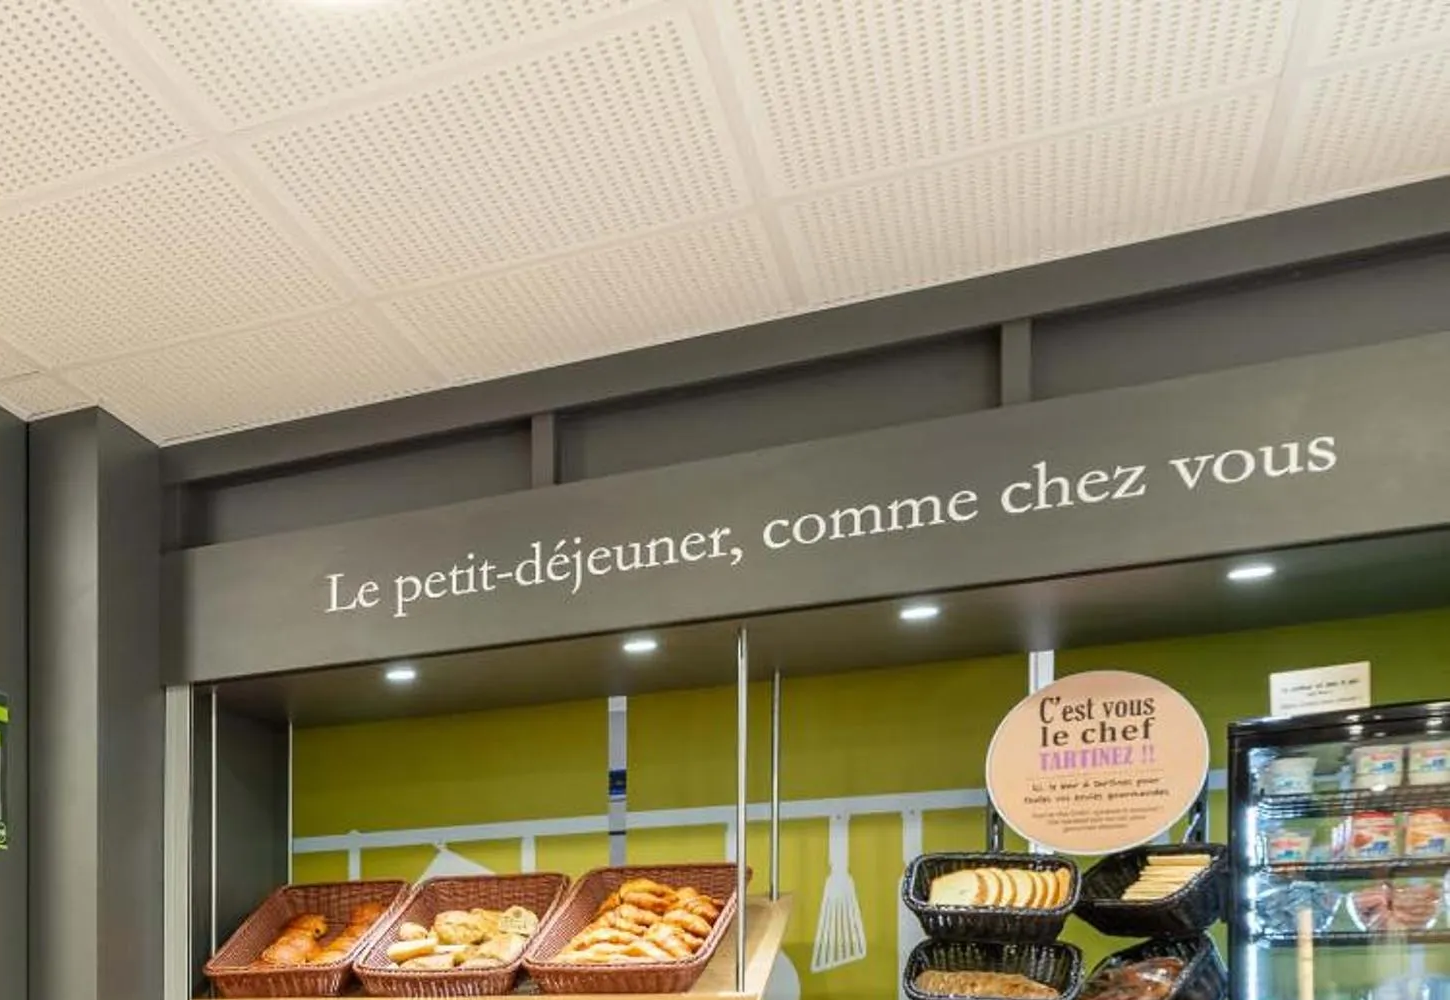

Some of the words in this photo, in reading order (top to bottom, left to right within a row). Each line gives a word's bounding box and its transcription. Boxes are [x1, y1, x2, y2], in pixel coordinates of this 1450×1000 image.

[324, 572, 382, 614] Le
[393, 525, 744, 619] petit-déjeuner,
[762, 487, 980, 550] comme
[1000, 460, 1148, 517] chez
[1168, 434, 1338, 492] vous
[1038, 695, 1095, 724] C'est
[1102, 697, 1156, 719] vous
[1040, 725, 1069, 748] le
[1080, 716, 1156, 744] chef
[1038, 745, 1134, 771] TARTINEZ
